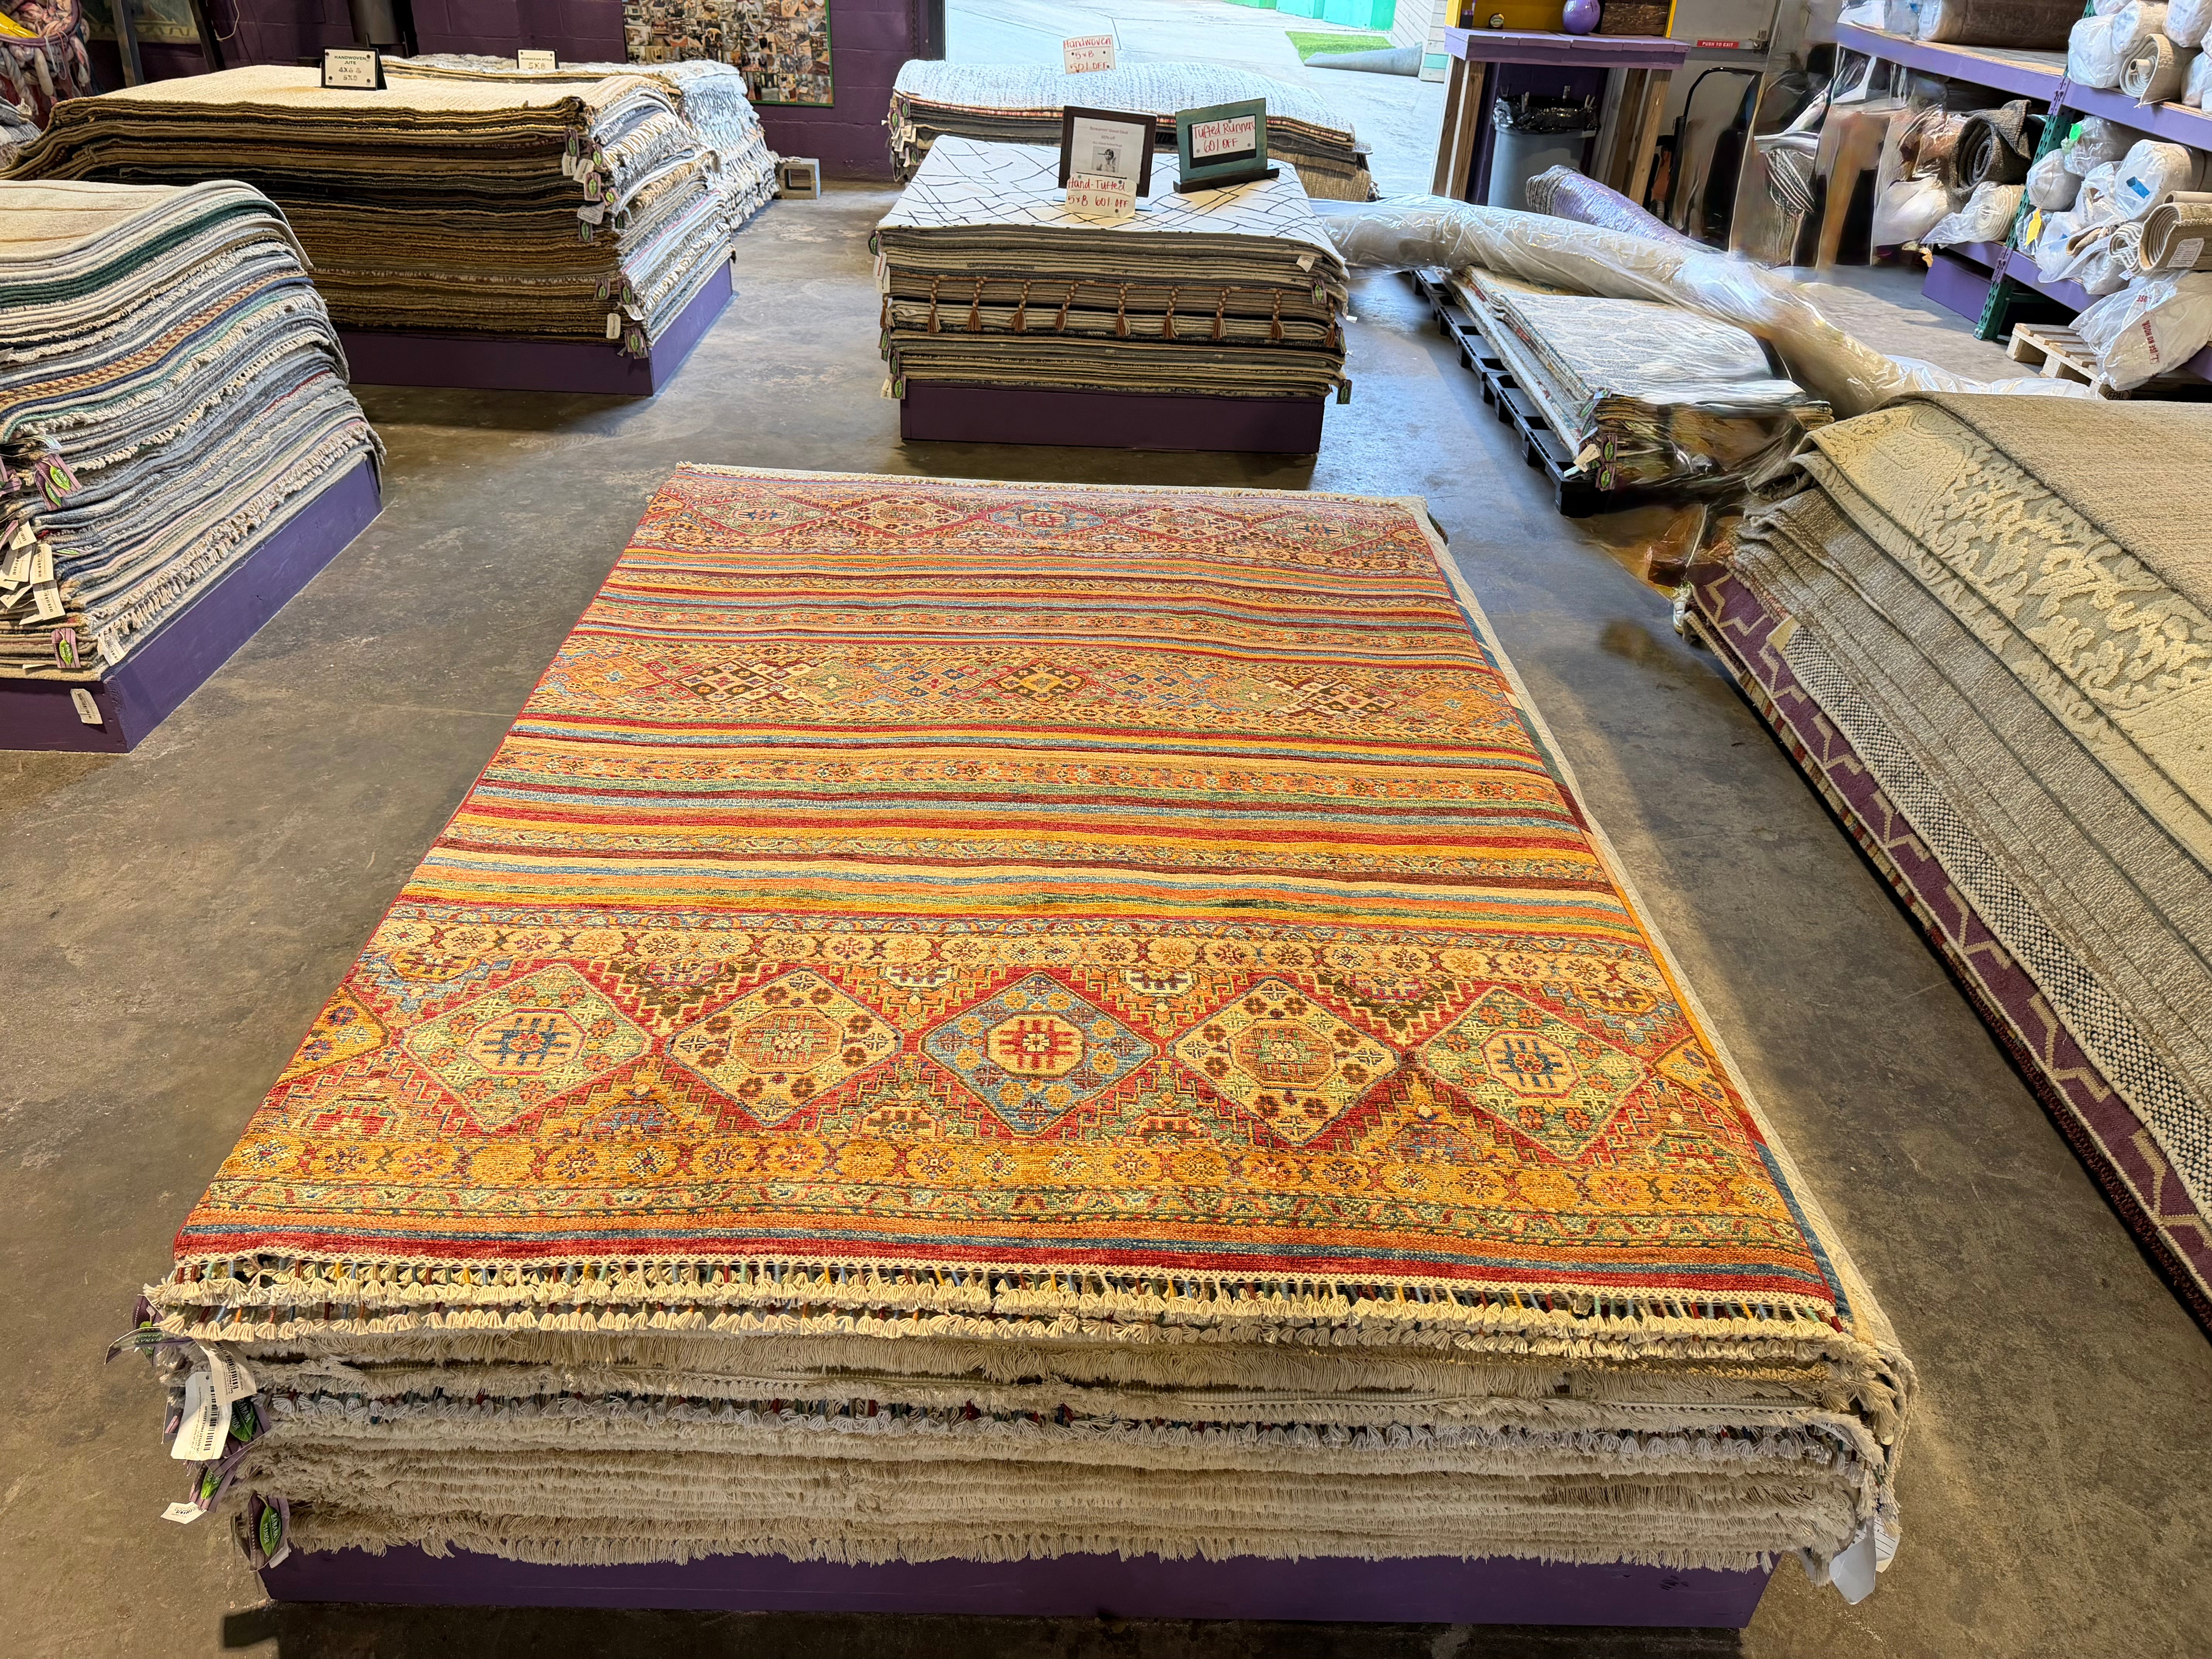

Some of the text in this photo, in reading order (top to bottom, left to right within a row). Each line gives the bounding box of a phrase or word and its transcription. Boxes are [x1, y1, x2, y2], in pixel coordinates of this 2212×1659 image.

[1063, 38, 1111, 50] Handwoven
[1092, 61, 1108, 69] OFF
[1192, 121, 1255, 139] Tufted Runners
[1222, 138, 1238, 149] OFF
[1115, 198, 1129, 208] OFF
[2147, 336, 2155, 344] NO
[2148, 344, 2158, 354] USE
[231, 1412, 240, 1431] ANOR
[271, 1513, 279, 1539] BANANA
